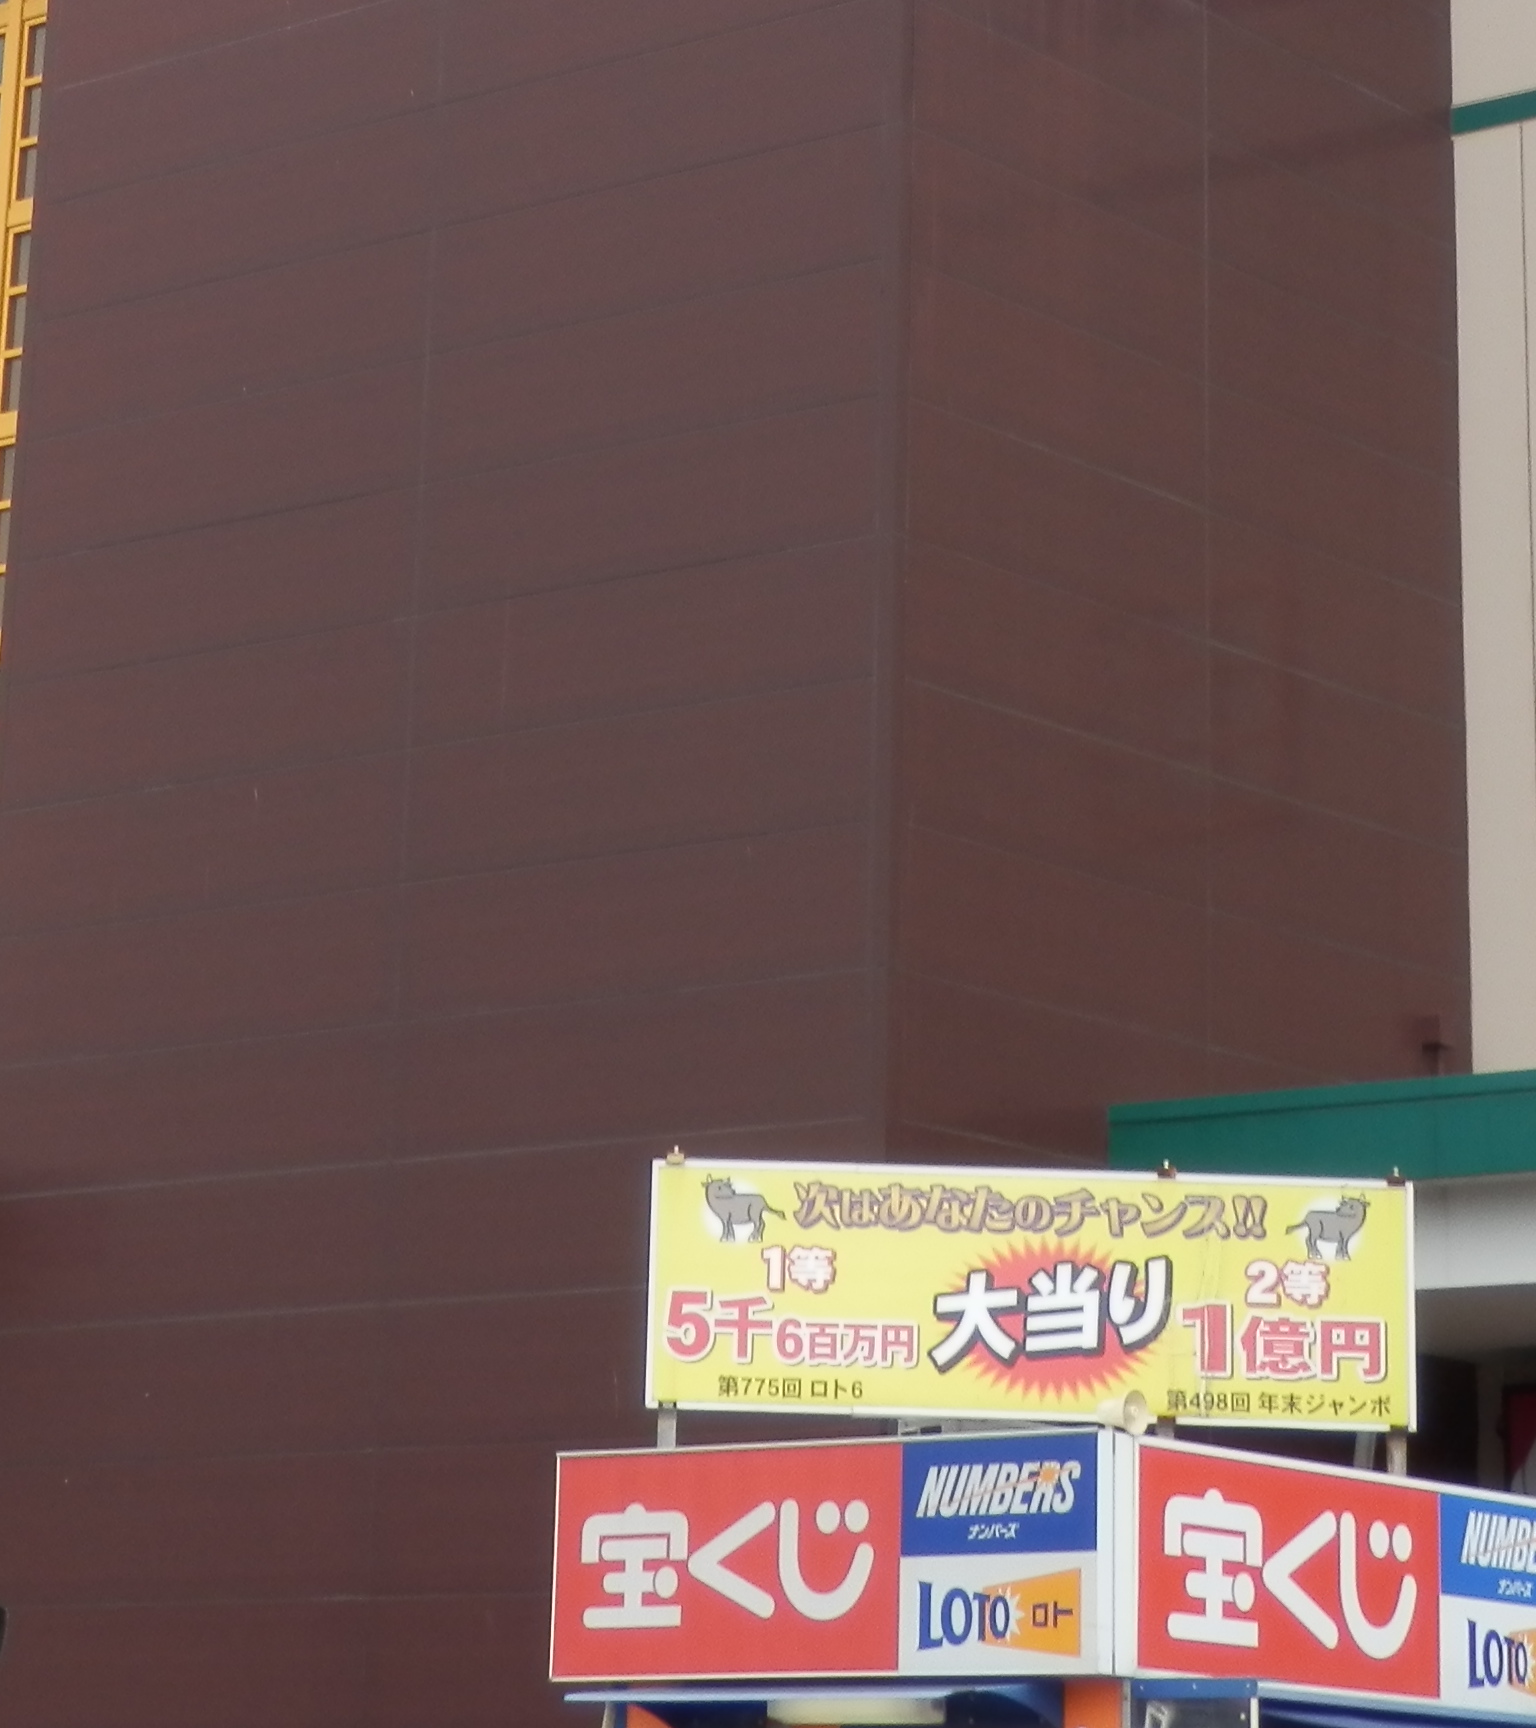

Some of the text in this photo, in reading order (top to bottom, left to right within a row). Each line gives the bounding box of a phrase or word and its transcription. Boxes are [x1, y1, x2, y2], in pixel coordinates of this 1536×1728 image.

[761, 1244, 837, 1294] 1等
[1244, 1259, 1330, 1308] 2等
[666, 1290, 919, 1368] 5千6百万円
[927, 1255, 1173, 1374] 大当り
[1181, 1302, 1388, 1382] 1億円
[717, 1375, 864, 1400] 第775回 ロト6
[1165, 1389, 1252, 1414] 第498回
[916, 1460, 1082, 1519] NUMBERS
[580, 1497, 875, 1630] 宝くじ
[1163, 1487, 1418, 1660] 宝くじ
[917, 1580, 1011, 1651] LOTO
[1466, 1618, 1529, 1690] LOTO
